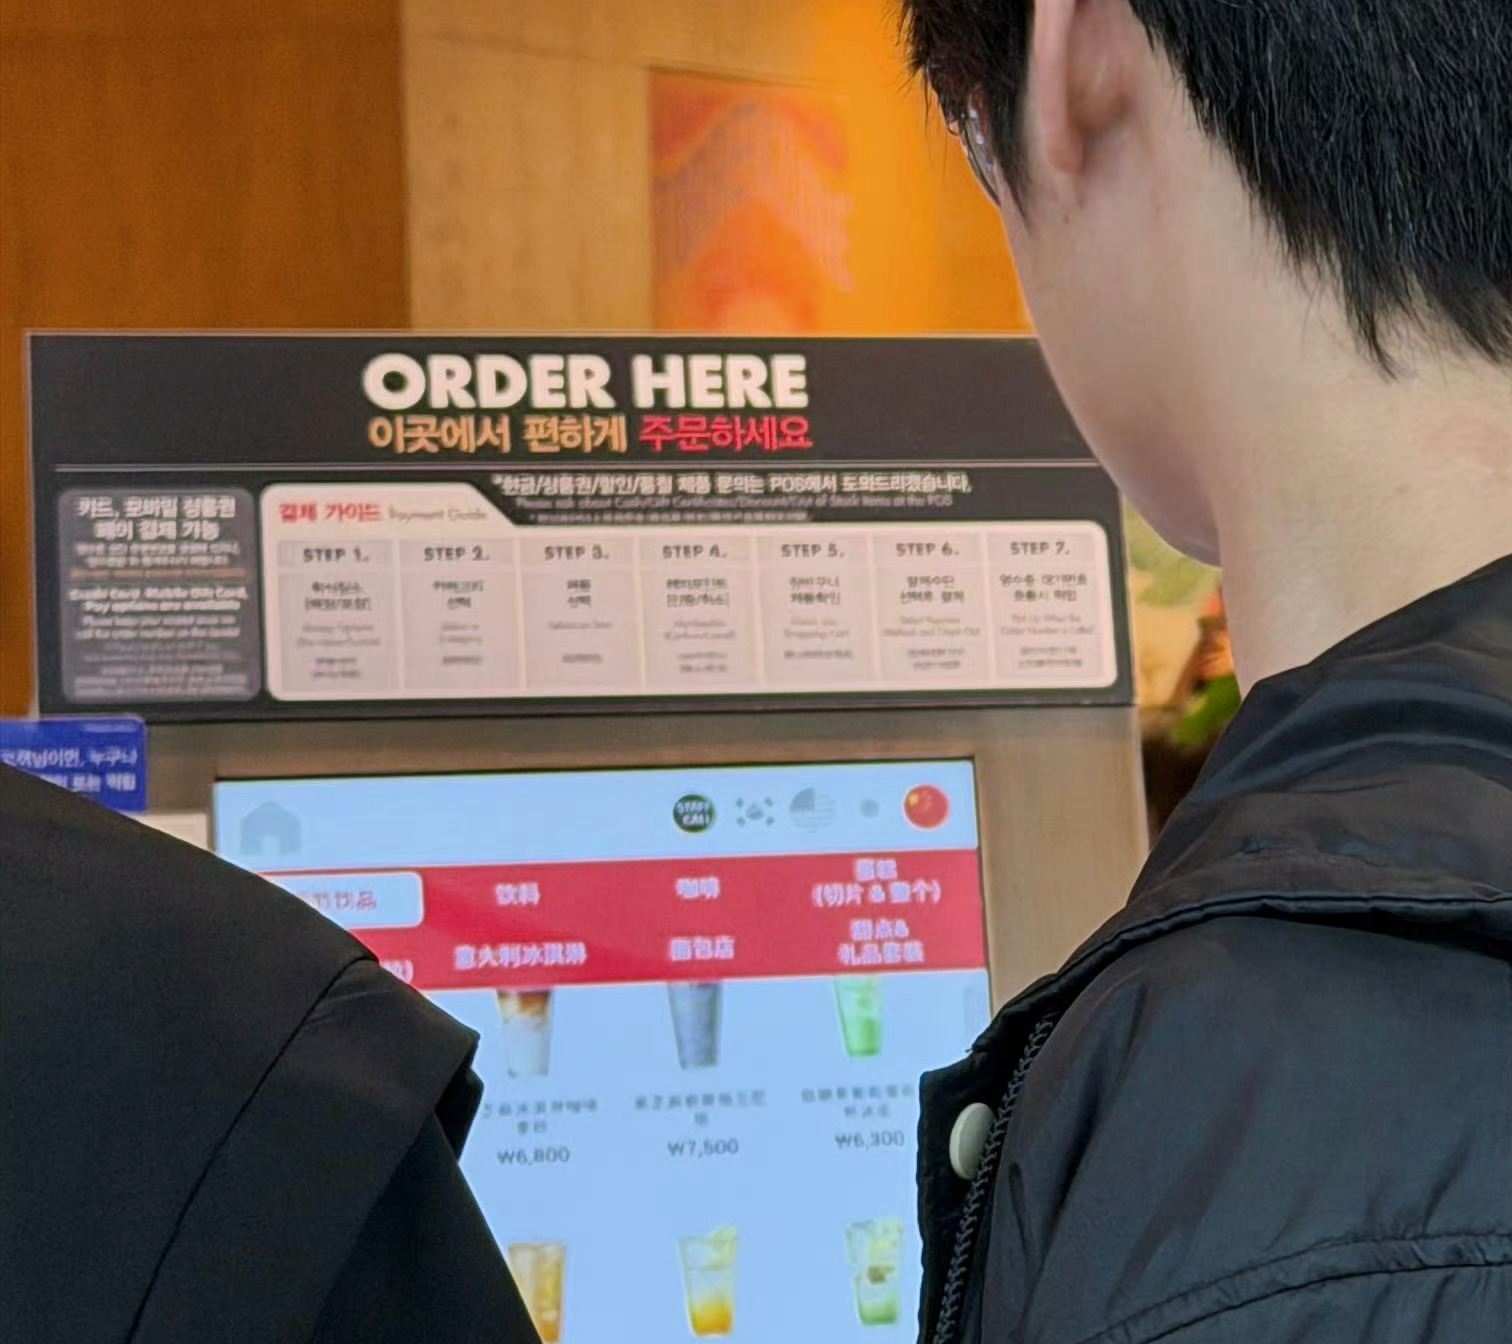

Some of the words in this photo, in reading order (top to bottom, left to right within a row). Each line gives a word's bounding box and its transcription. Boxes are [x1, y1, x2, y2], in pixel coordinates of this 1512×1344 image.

[362, 353, 616, 410] ORDER
[631, 354, 809, 409] HERE
[369, 415, 512, 453] 이곳에서
[522, 415, 628, 453] 편하게
[638, 415, 813, 453] 주문하세요
[303, 548, 346, 561] STEP
[424, 547, 465, 561] STEP
[545, 546, 585, 560] STEP
[663, 545, 703, 558] STEP
[781, 544, 821, 557] STEP
[896, 543, 936, 556] STEP
[1010, 542, 1049, 555] STEP
